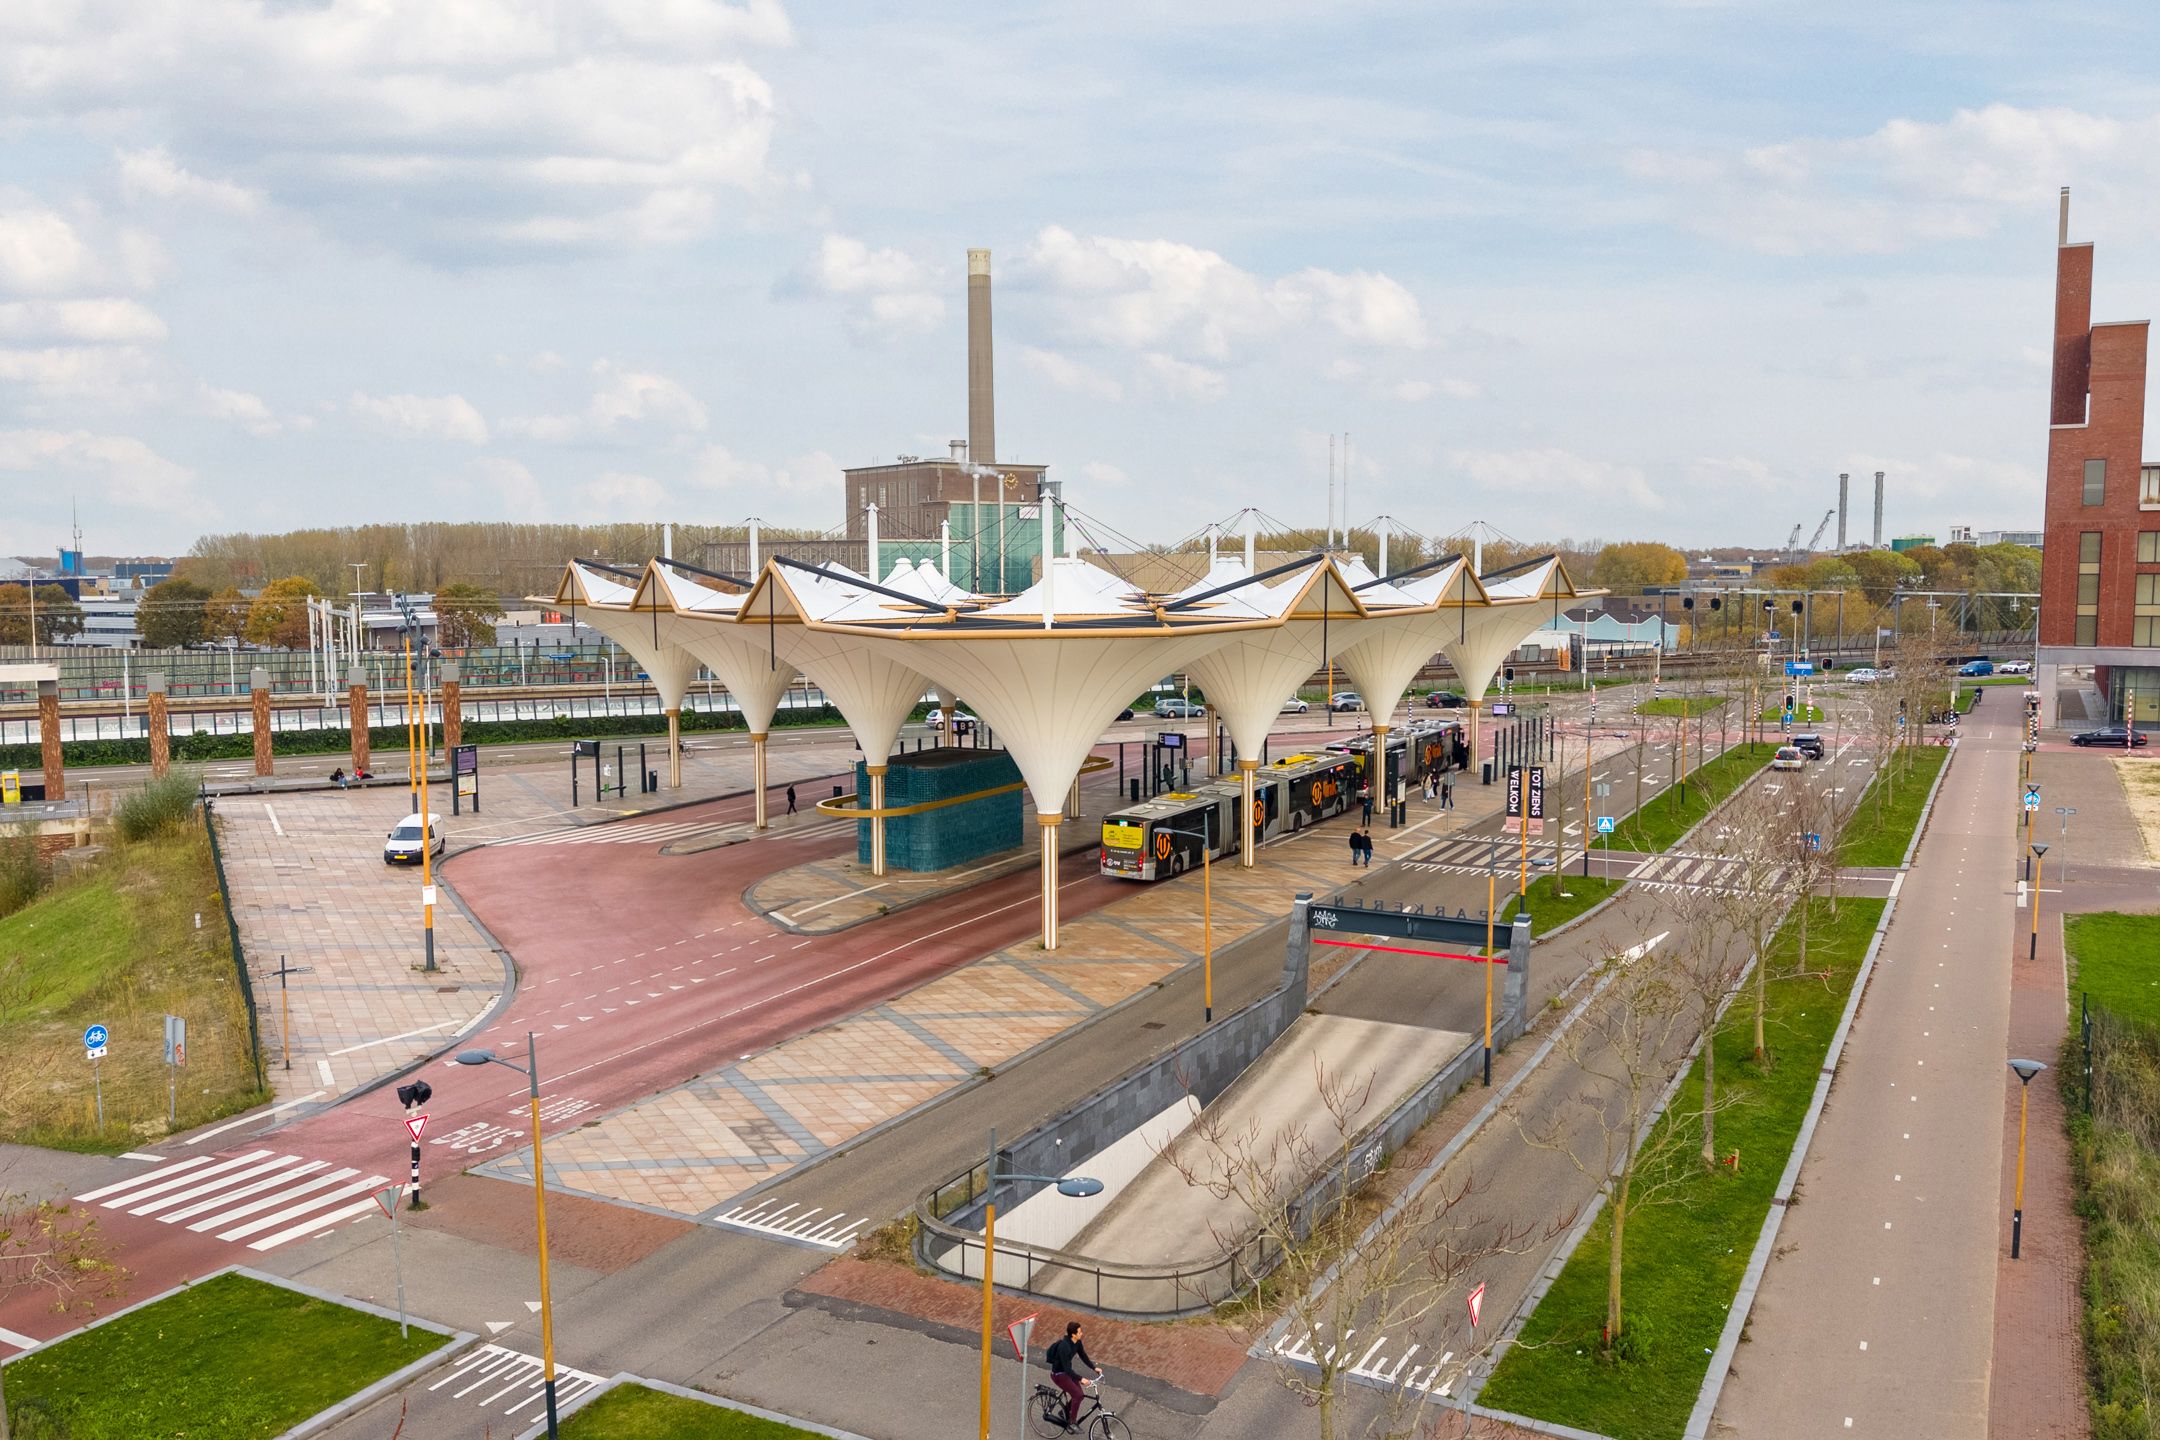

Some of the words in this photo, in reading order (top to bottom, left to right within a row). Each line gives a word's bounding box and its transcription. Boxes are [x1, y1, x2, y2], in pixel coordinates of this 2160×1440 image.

[960, 722, 966, 730] B
[575, 742, 582, 751] A
[1159, 735, 1164, 743] E
[1531, 770, 1541, 787] TOT
[1509, 770, 1519, 812] WELKOM
[1531, 789, 1541, 816] ZIENS
[429, 1122, 525, 1154] BUS
